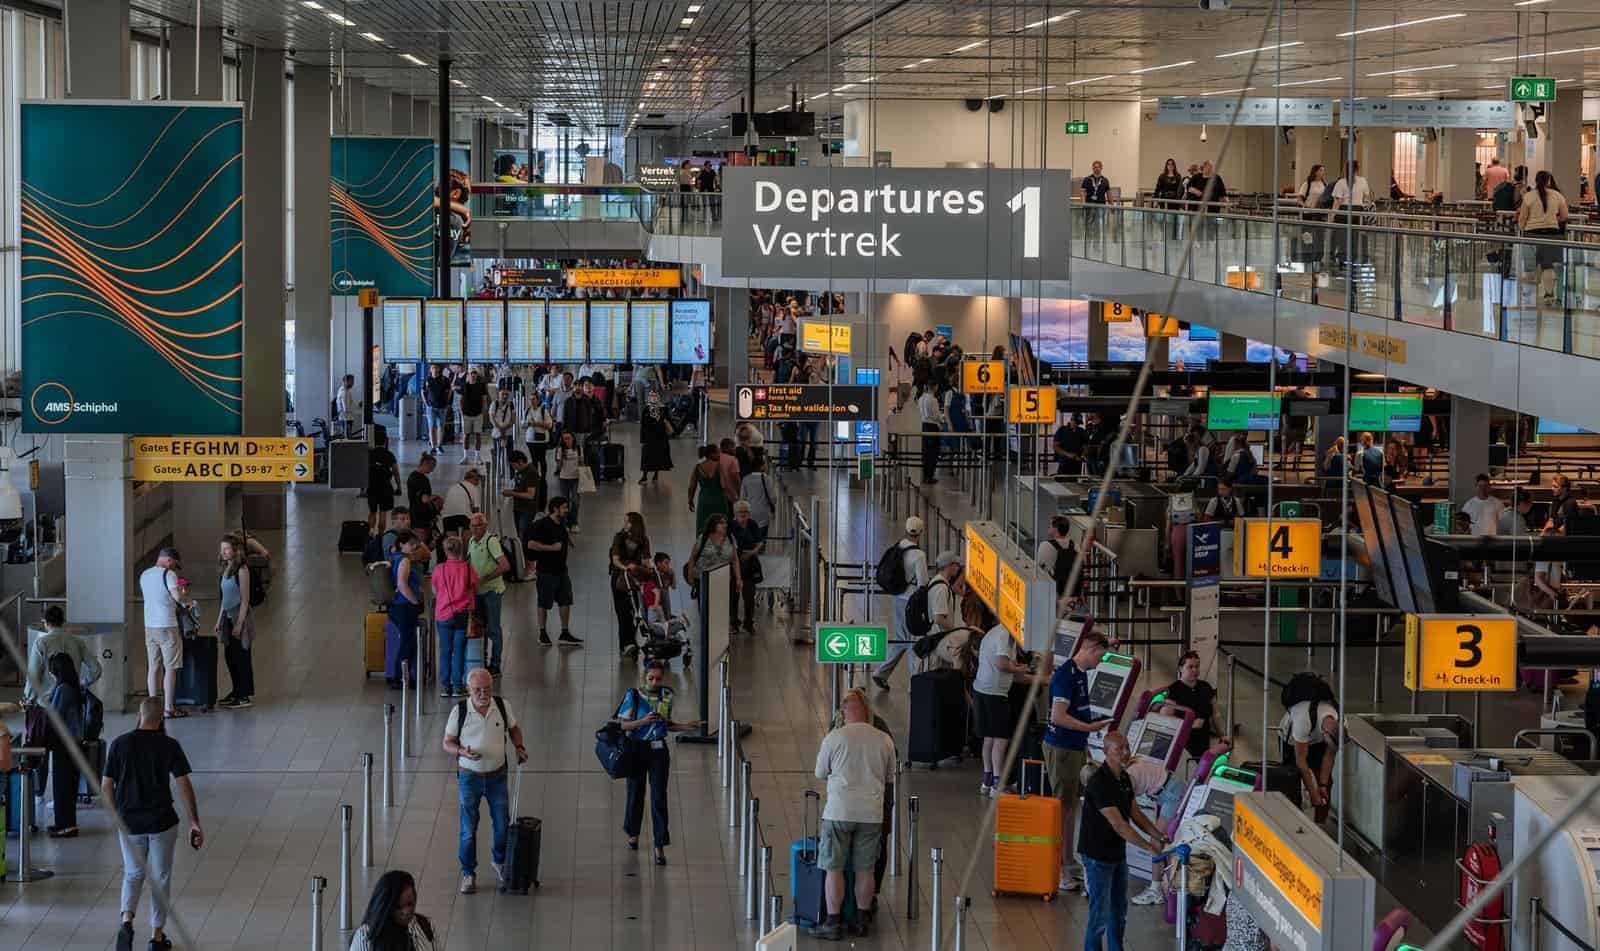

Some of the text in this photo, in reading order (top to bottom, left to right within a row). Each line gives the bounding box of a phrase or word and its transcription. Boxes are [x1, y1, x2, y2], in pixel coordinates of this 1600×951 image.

[755, 181, 984, 221] Departures
[1006, 186, 1040, 258] 1
[752, 223, 902, 257] Vertrek
[1113, 302, 1122, 316] 8
[978, 364, 991, 384] 6
[768, 387, 802, 395] First aid
[45, 402, 118, 414] AMS Schiphol
[768, 404, 846, 412] Tax free validaion
[1026, 391, 1039, 412] 5
[140, 443, 168, 452] Gates
[171, 441, 239, 455] EFGHM
[153, 463, 272, 477] Gates ABC D 59-87
[1270, 526, 1293, 559] 4
[1272, 564, 1309, 572] Check-in
[1454, 625, 1482, 668] 3
[1453, 674, 1500, 685] Check-in
